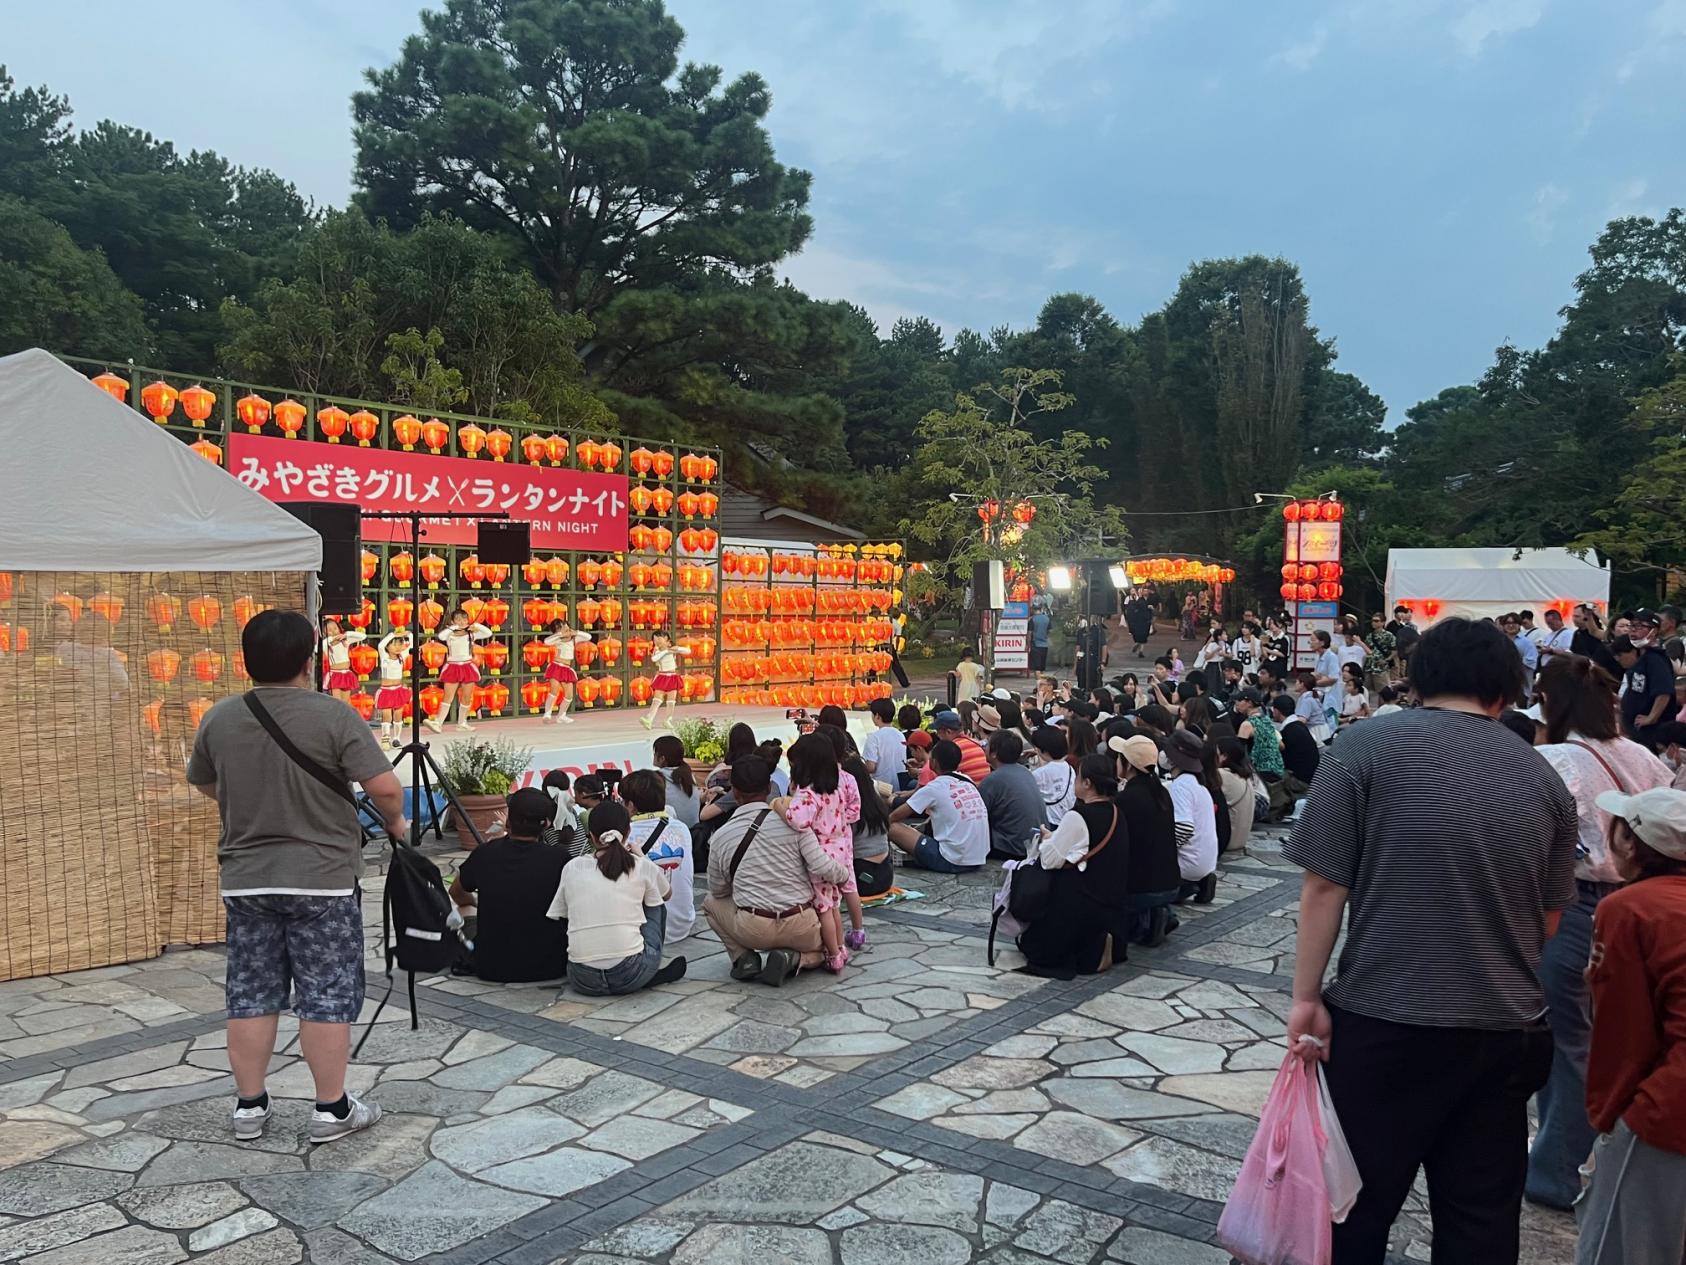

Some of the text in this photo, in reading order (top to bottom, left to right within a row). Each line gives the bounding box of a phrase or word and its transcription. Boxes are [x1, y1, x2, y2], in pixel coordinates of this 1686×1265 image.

[471, 478, 626, 518] ランタンナイト
[558, 521, 599, 534] NIGHT
[994, 639, 1022, 647] KIRIN
[1237, 650, 1252, 665] 98
